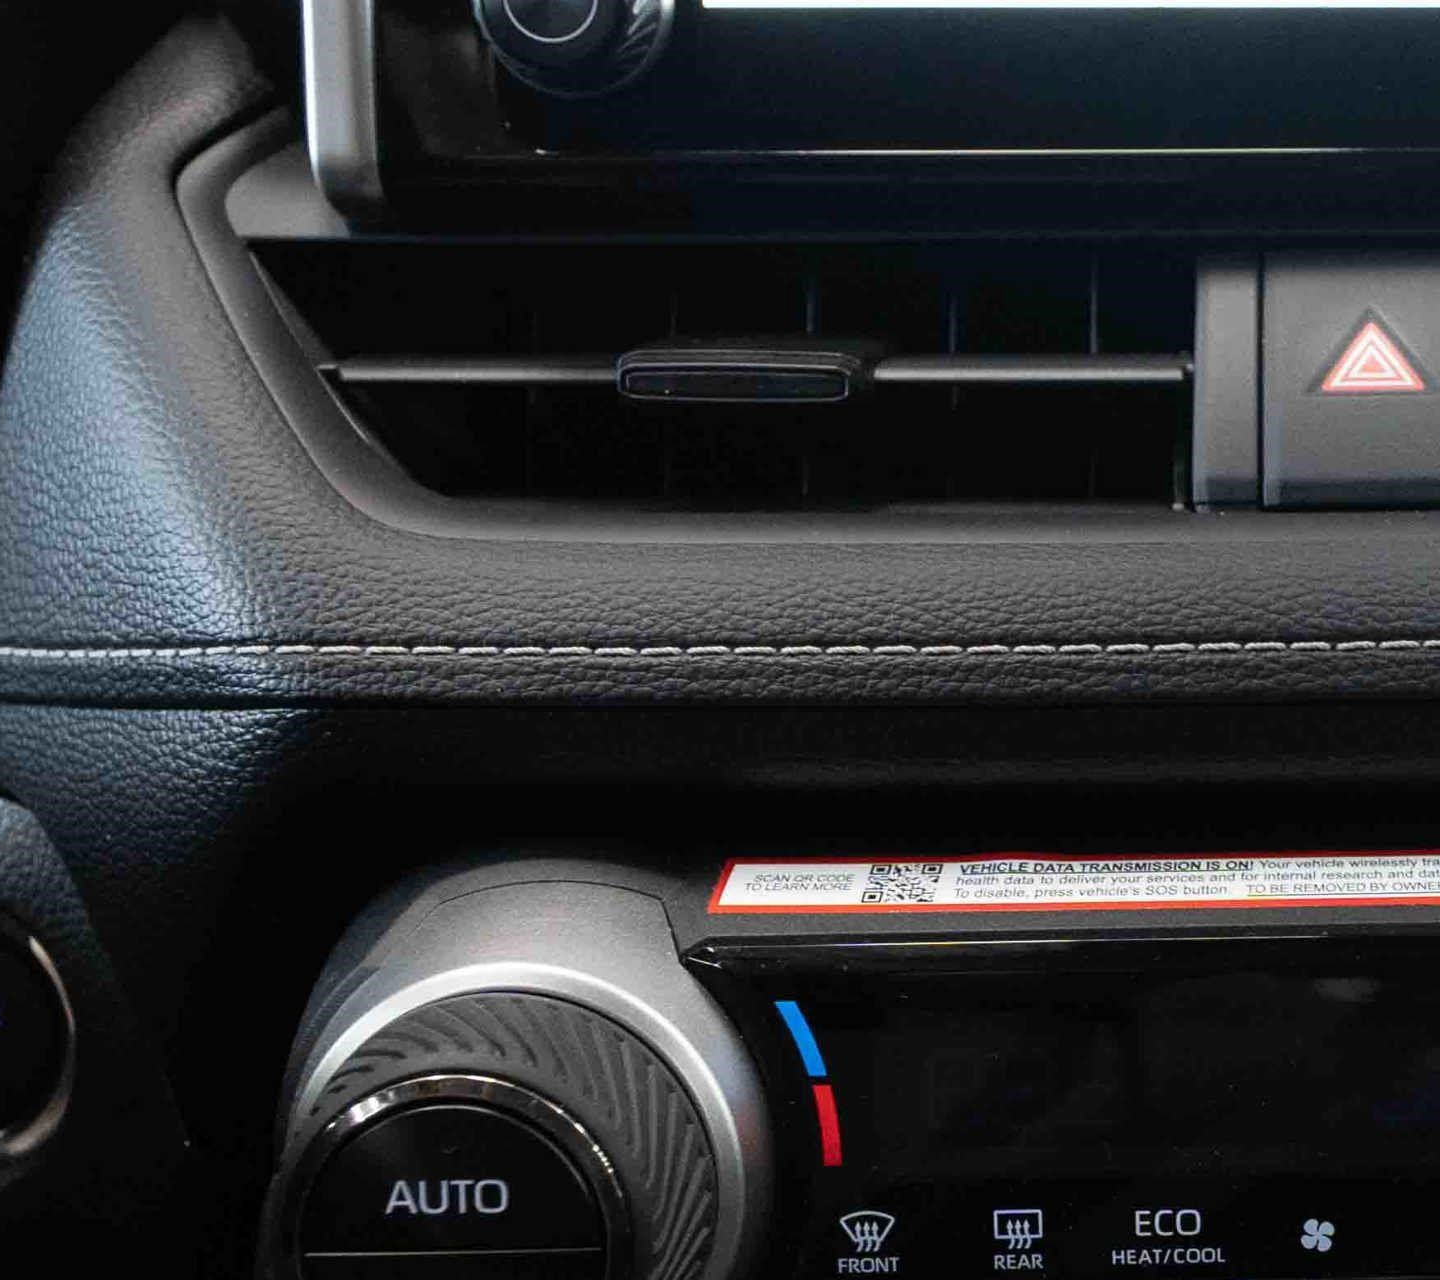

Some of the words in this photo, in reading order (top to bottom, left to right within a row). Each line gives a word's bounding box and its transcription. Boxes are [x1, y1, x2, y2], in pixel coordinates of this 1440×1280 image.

[960, 862, 1033, 873] VEHICLE
[1034, 862, 1074, 873] DATA
[1079, 861, 1202, 872] TRANSMISSION
[1206, 861, 1221, 871] IS
[1225, 860, 1254, 870] ON!
[1260, 859, 1290, 869] Your
[1295, 858, 1344, 869] vehicle
[1349, 857, 1417, 868] wirelessly
[754, 874, 791, 882] SCAN
[817, 873, 856, 882] CODE
[956, 875, 999, 885] health
[1003, 875, 1034, 885] data
[1040, 875, 1054, 884] to
[1060, 875, 1106, 884] deliver
[1110, 876, 1142, 887] your
[1146, 873, 1204, 883] services
[1210, 872, 1236, 882] and
[1241, 871, 1259, 881] for
[1264, 871, 1316, 881] internal
[1321, 870, 1383, 880] research
[1387, 869, 1414, 879] and
[746, 883, 762, 891] TO
[765, 883, 811, 891] LEARN
[815, 882, 853, 891] MORE
[953, 888, 969, 898] To
[1034, 888, 1073, 899] press
[1078, 886, 1140, 897] vehicle's
[1145, 885, 1178, 895] SOS
[1246, 884, 1266, 894] TO
[1270, 883, 1290, 893] BE
[1293, 882, 1366, 893] REMOVED
[1369, 882, 1389, 892] BY
[385, 1179, 510, 1215] AUTO
[1134, 1209, 1202, 1237] ECO
[837, 1256, 900, 1274] FRONT
[994, 1253, 1044, 1270] REAR
[1111, 1247, 1226, 1266] HEAT/COOL
